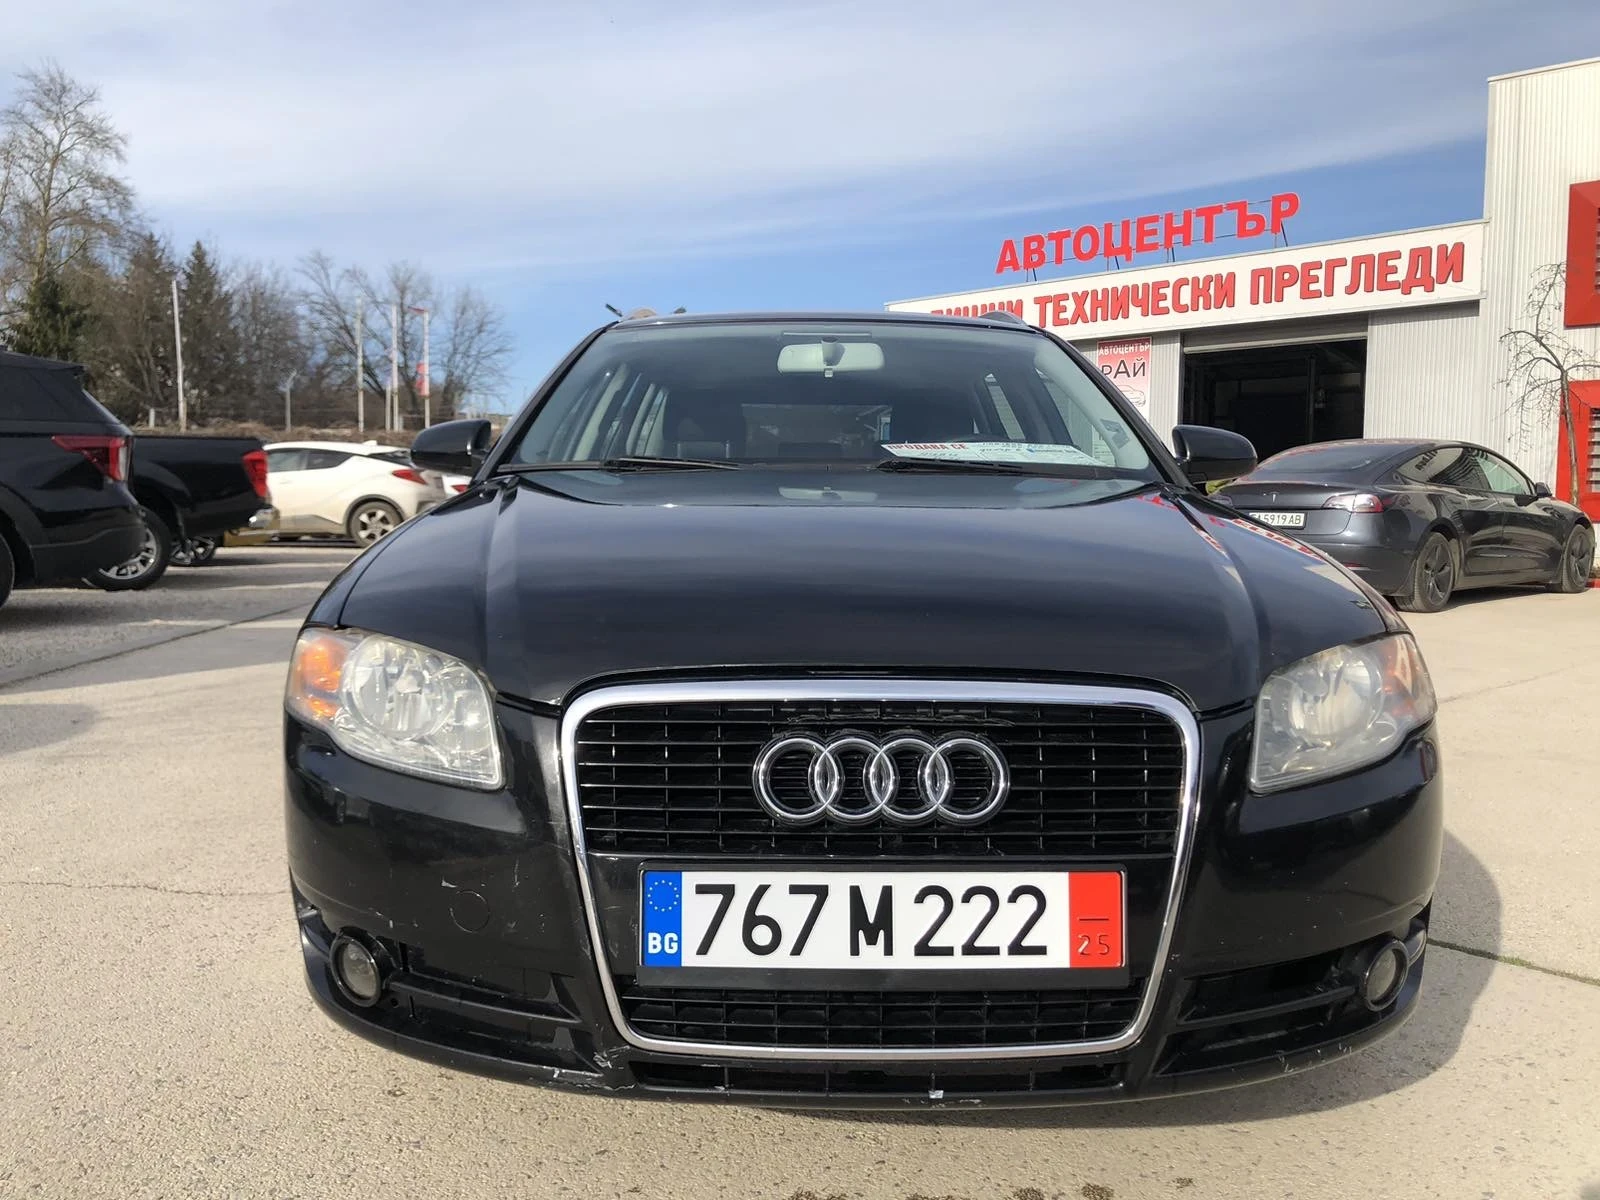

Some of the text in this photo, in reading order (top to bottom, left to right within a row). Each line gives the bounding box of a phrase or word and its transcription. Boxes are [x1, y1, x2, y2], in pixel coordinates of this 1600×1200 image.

[995, 192, 1300, 274] АВТОЦЕНТЪР
[1033, 242, 1464, 328] ТЕХНИЧЕСКИ ПРЕГЛЕДИ
[1098, 342, 1150, 356] АВТОЦЕНТЪР
[647, 931, 679, 955] BG
[694, 883, 1048, 956] 767 M 222
[1077, 934, 1110, 956] 25
